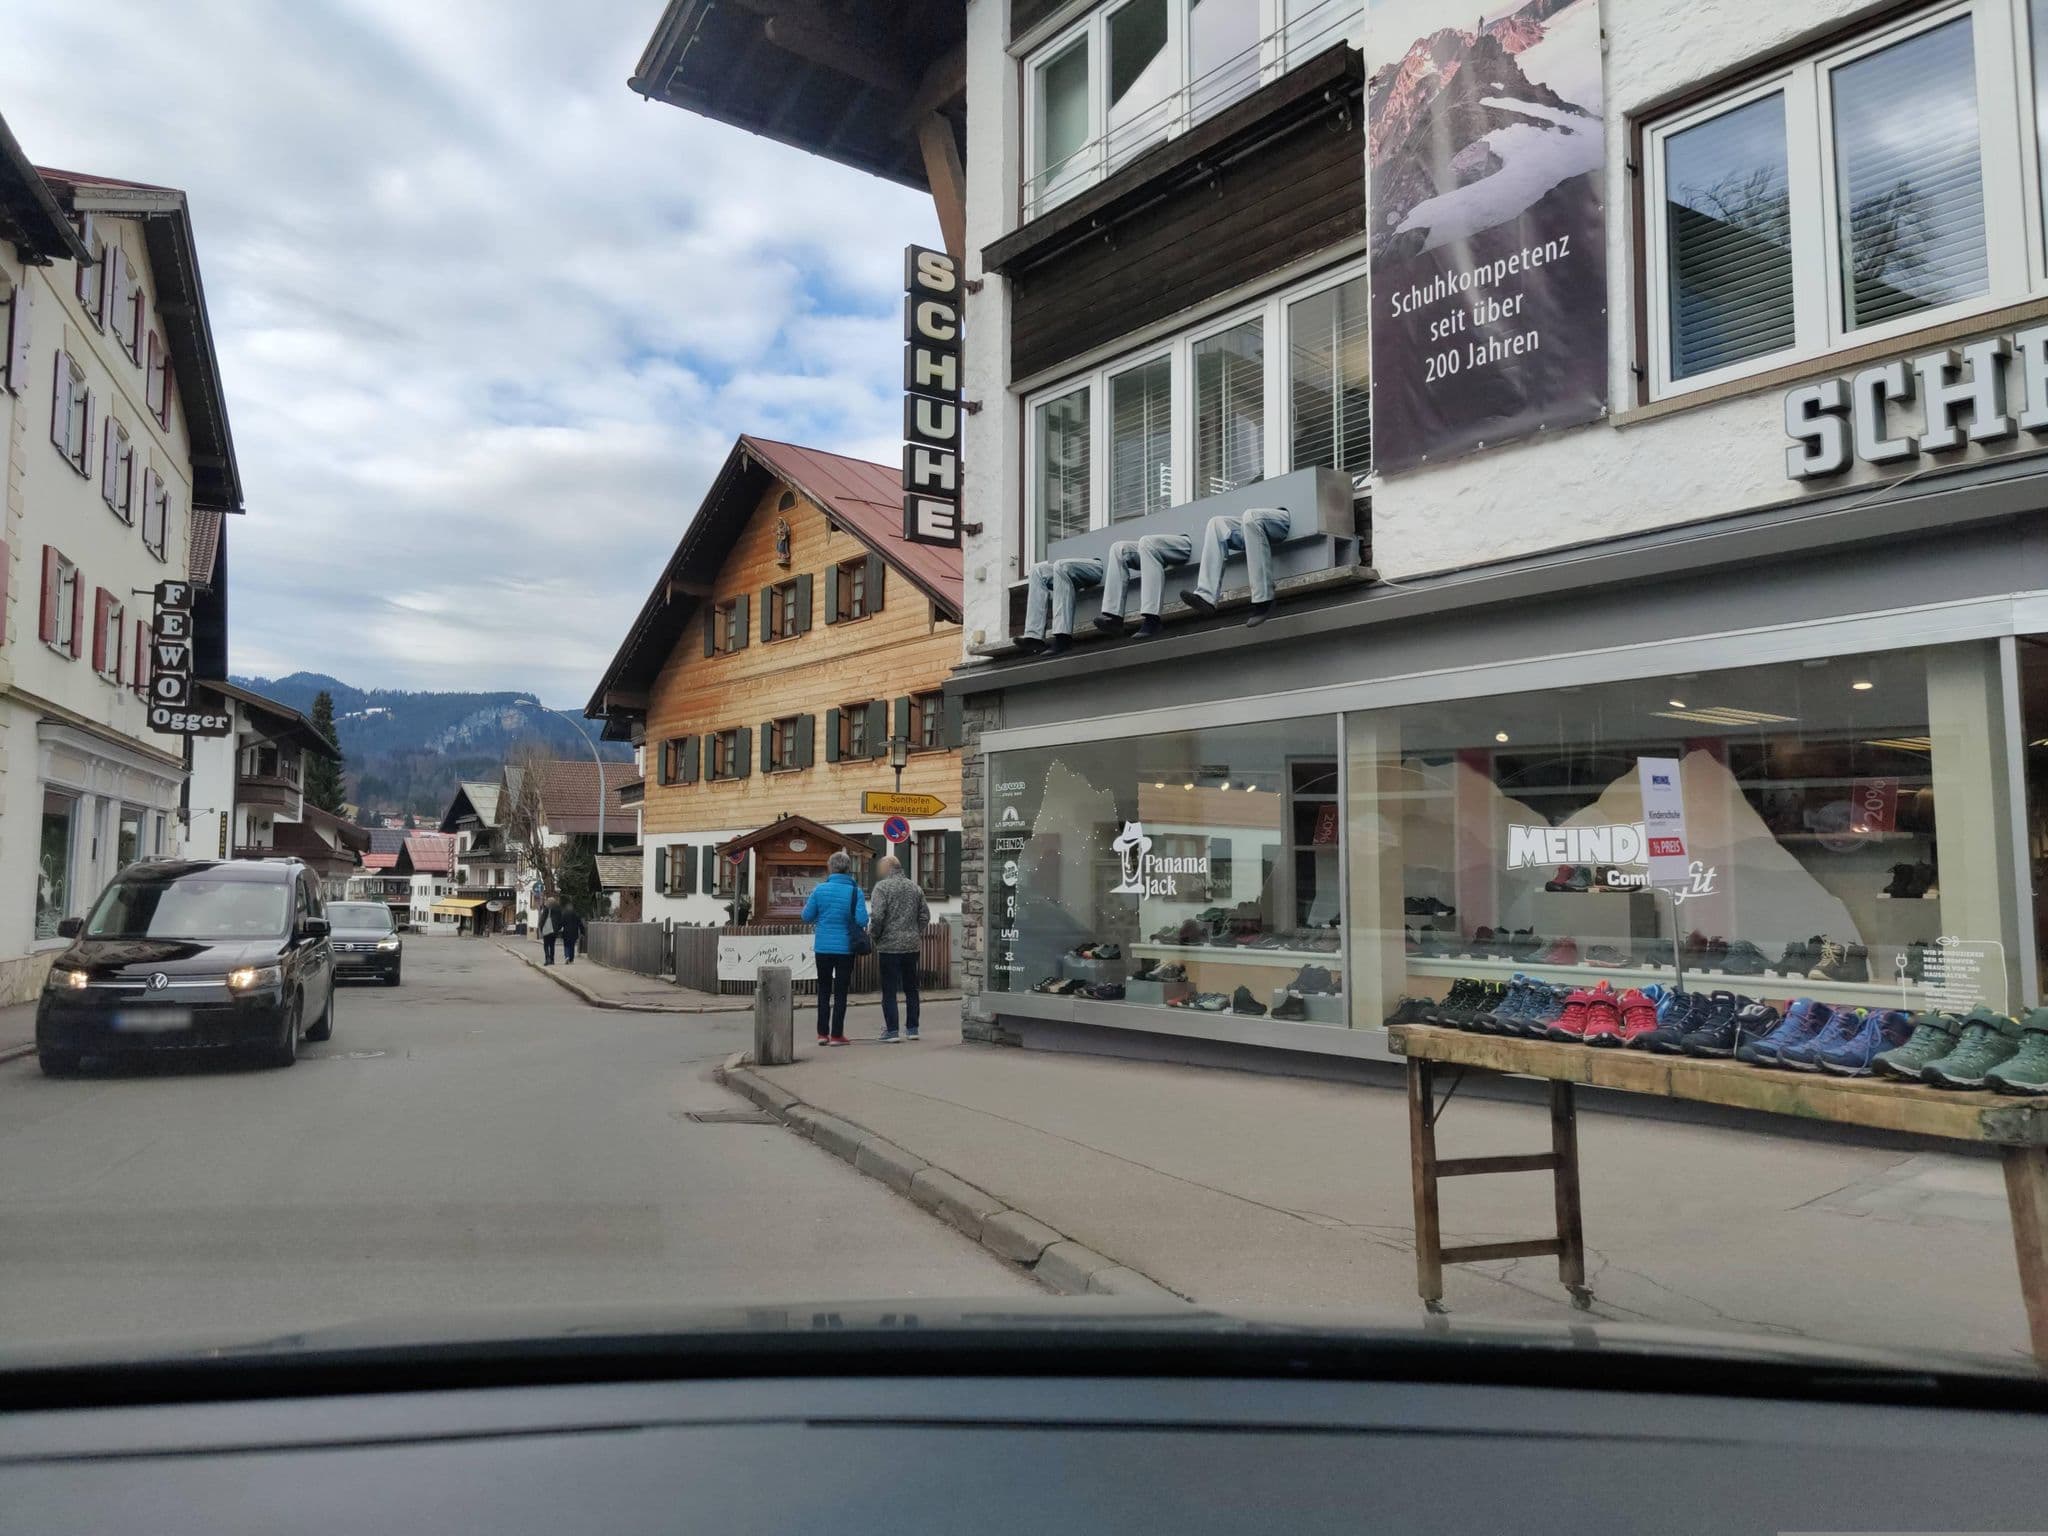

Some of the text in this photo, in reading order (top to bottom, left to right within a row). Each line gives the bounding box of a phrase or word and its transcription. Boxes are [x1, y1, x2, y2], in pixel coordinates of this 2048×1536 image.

[1391, 234, 1570, 318] Schuhkompetenz
[1430, 293, 1524, 342] seit über
[1425, 330, 1539, 383] 200 Jahren
[915, 250, 957, 540] SCHUHE
[157, 583, 186, 698] FEWO
[152, 708, 228, 731] Ogger
[873, 802, 930, 814] Kleinwalsertal
[890, 794, 930, 805] Sonthofen
[1144, 854, 1208, 874] Panama
[1144, 875, 1178, 901] Jack
